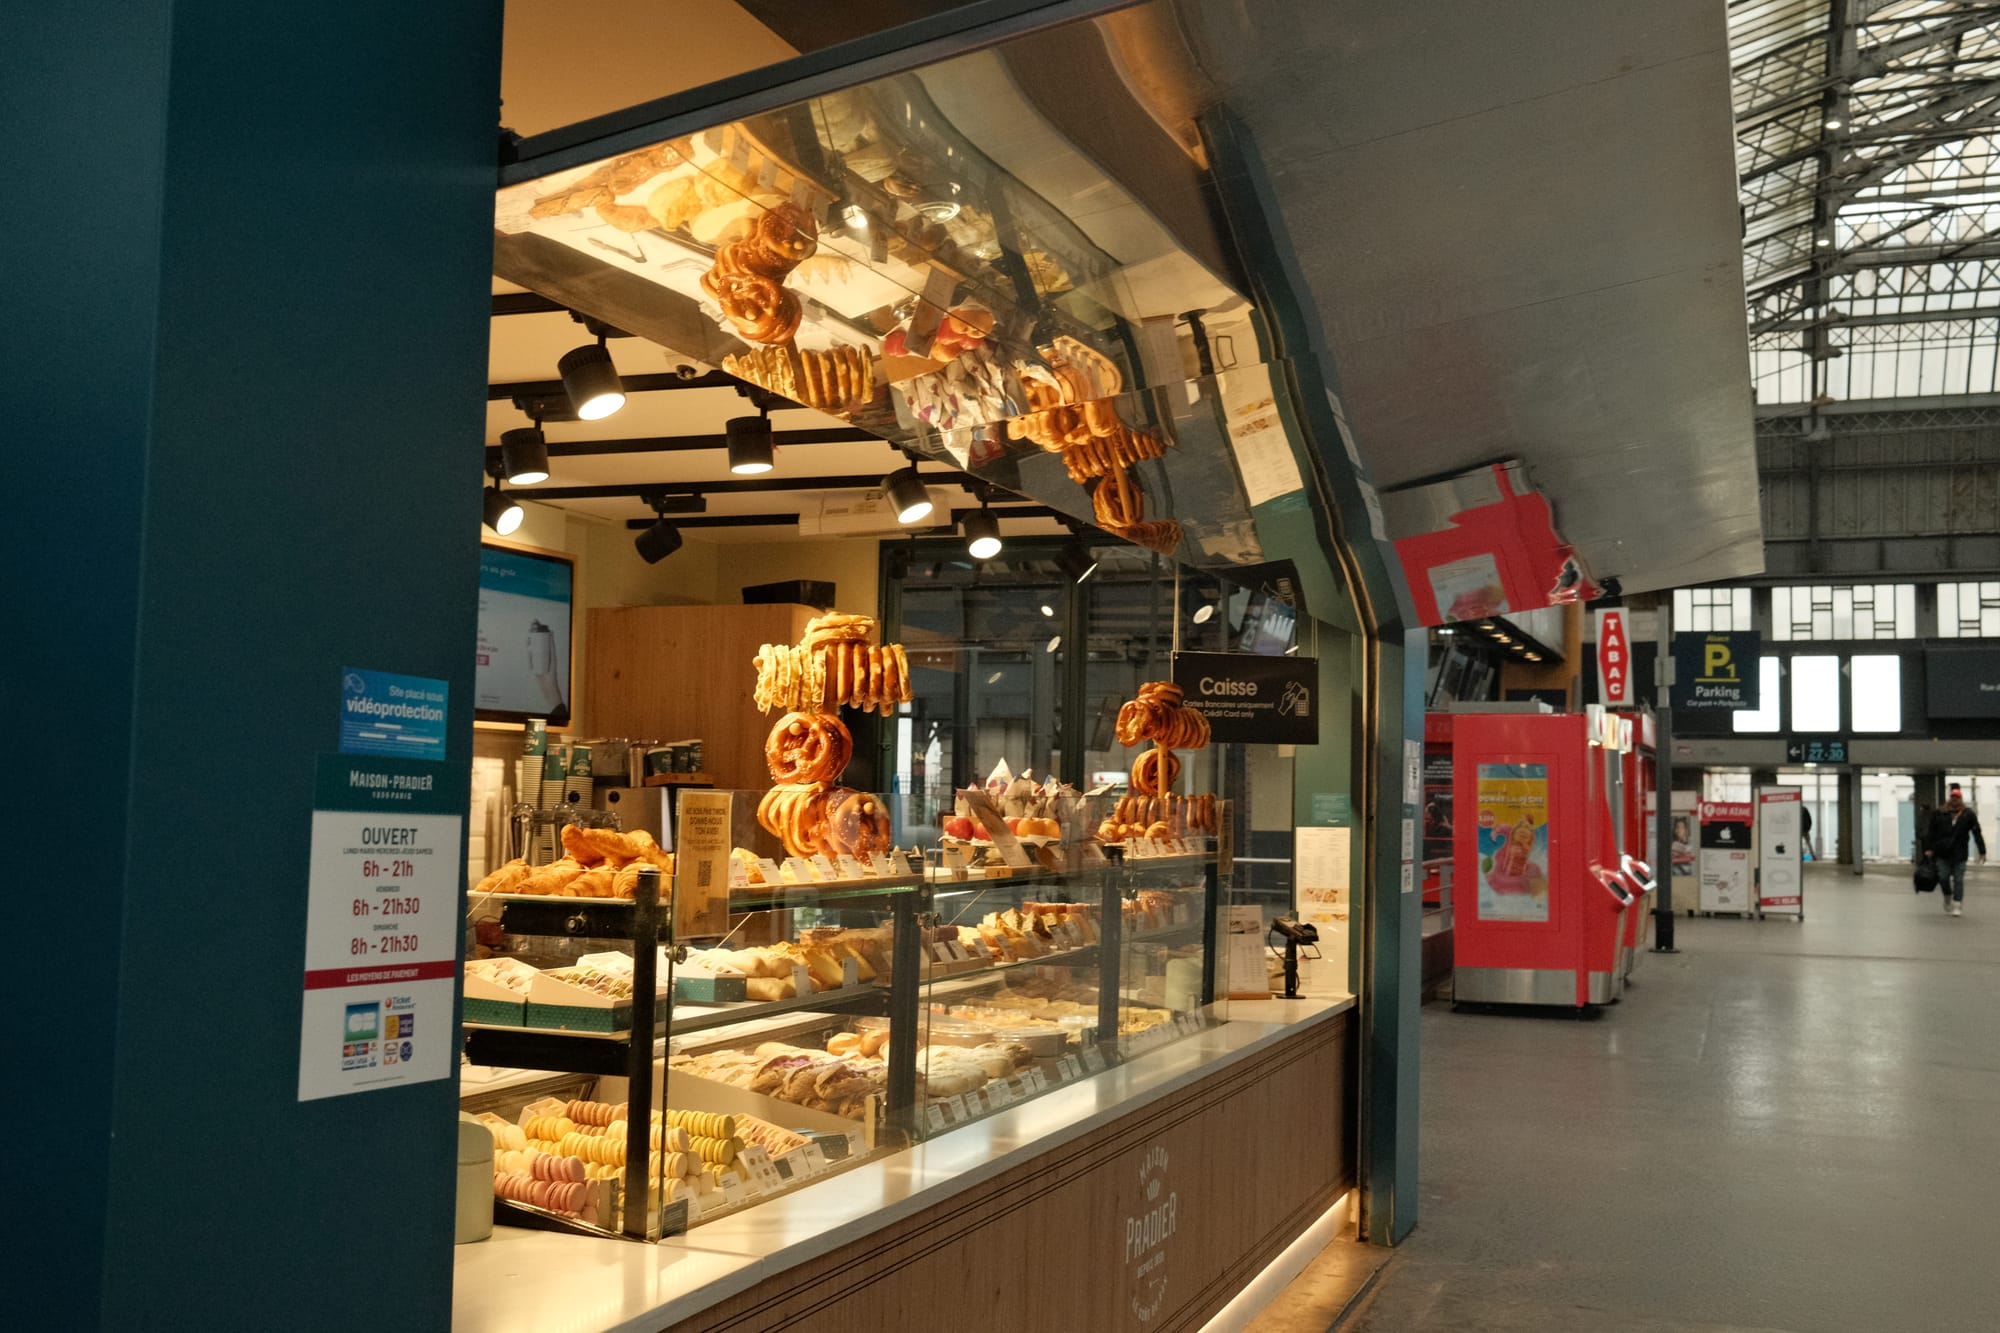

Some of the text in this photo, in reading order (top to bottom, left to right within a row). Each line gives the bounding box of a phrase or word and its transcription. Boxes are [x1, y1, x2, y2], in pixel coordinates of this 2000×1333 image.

[1606, 619, 1622, 695] TABAC
[389, 685, 444, 702] Site placé sous
[1200, 677, 1258, 696] Caisse
[1695, 686, 1740, 700] Parking
[346, 696, 443, 720] vidéoprotection
[349, 770, 433, 790] MAISON PRADIER
[362, 827, 418, 845] OUVERT
[363, 860, 379, 877] 6h
[392, 860, 413, 877] 21h
[353, 899, 369, 916] 6h
[382, 897, 420, 915] 21h30
[351, 937, 367, 955] 8h
[380, 934, 418, 953] 21h30
[1126, 1191, 1177, 1264] PRADIER
